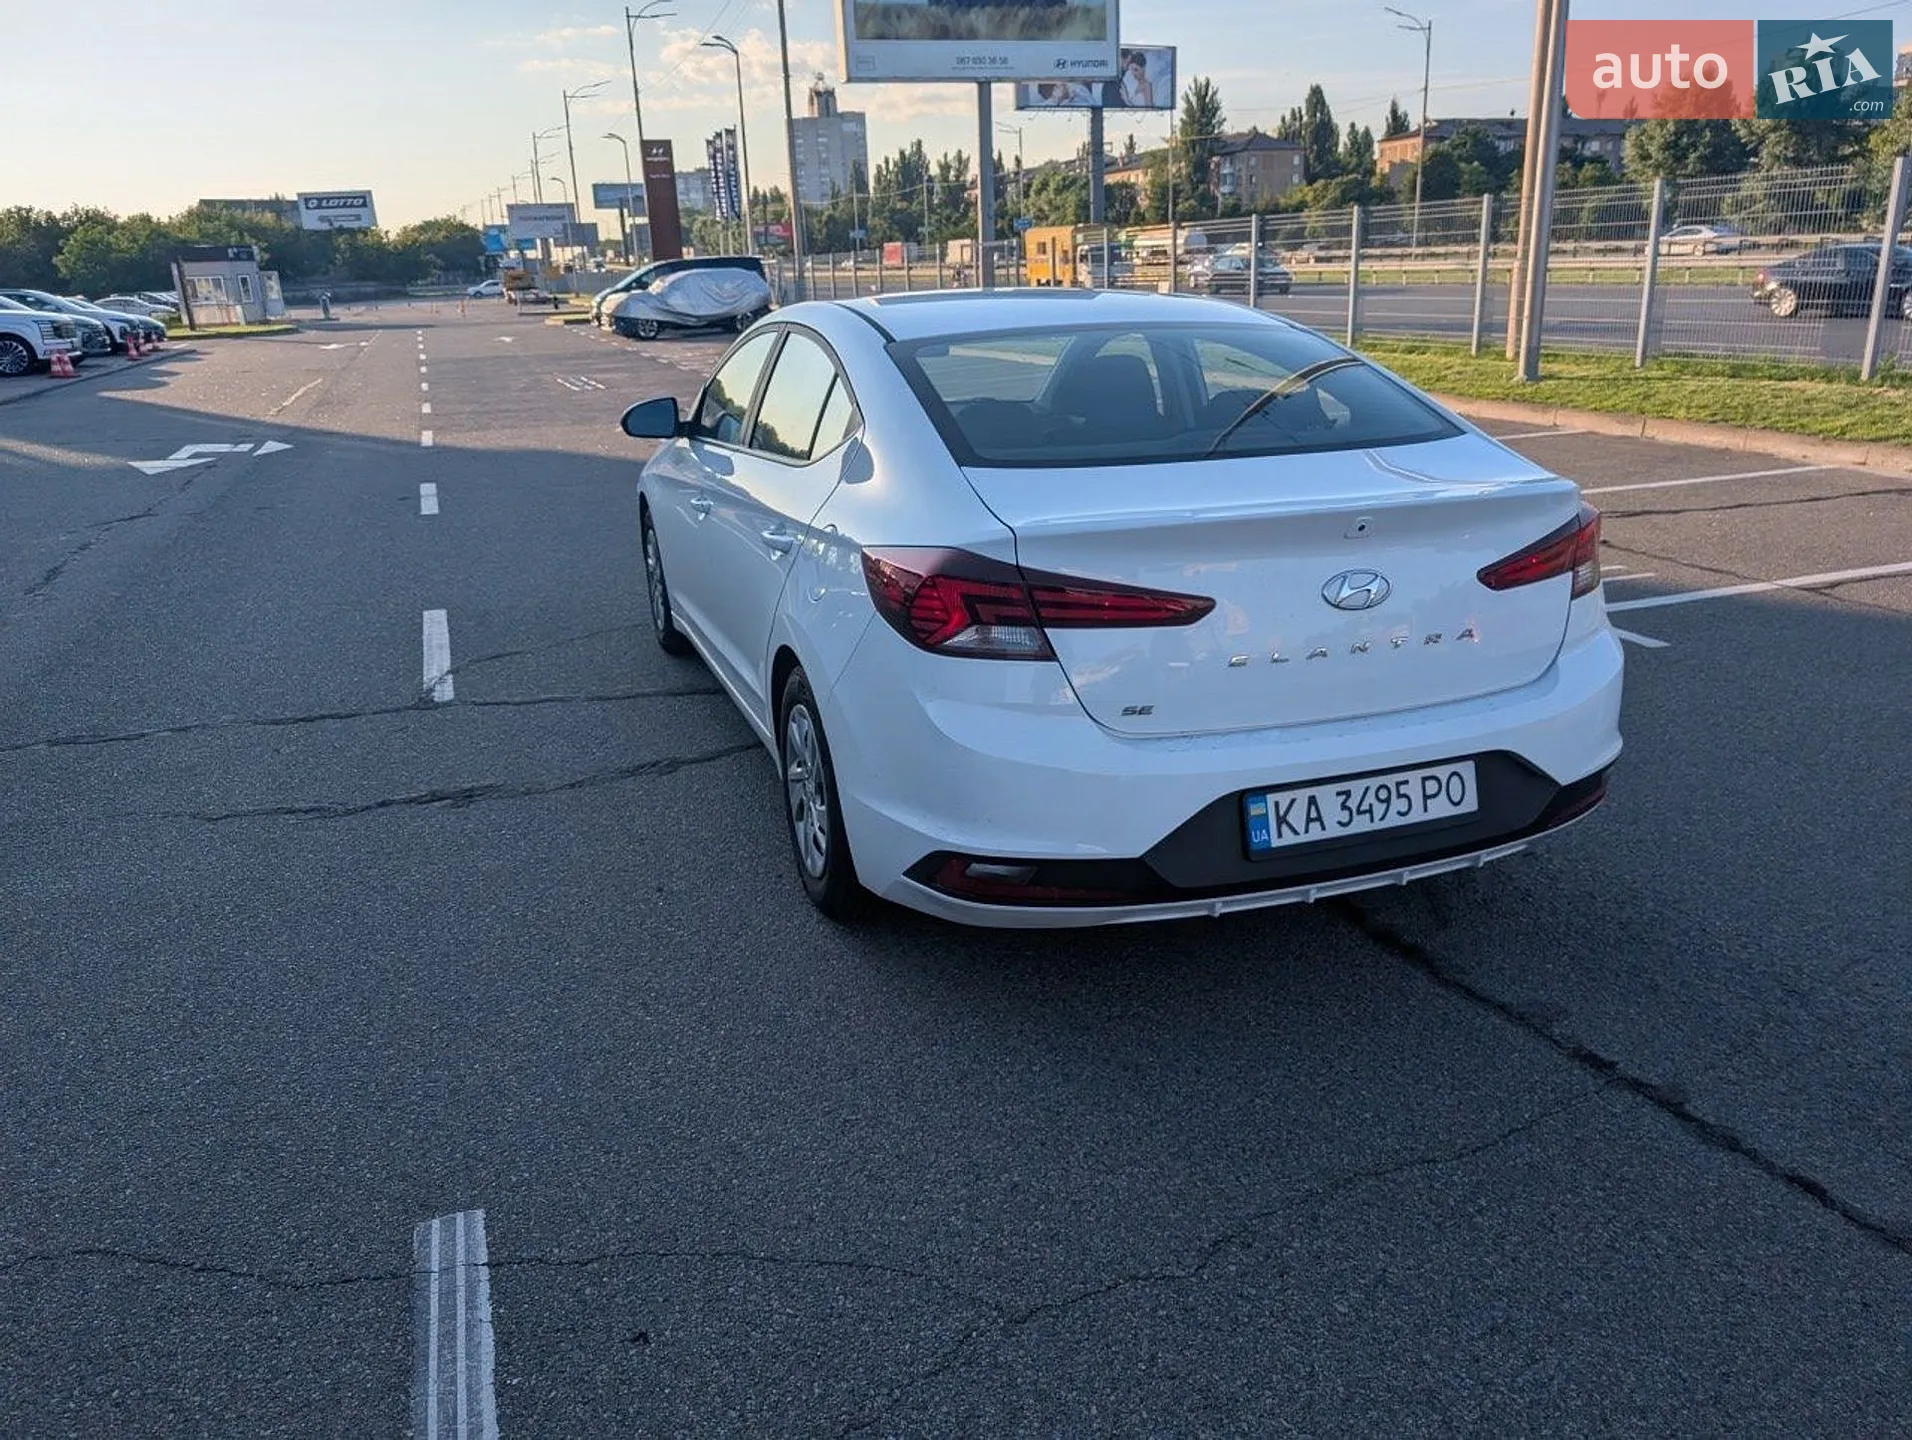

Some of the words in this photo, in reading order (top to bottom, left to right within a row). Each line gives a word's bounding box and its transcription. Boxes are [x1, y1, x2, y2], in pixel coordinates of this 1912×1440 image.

[1069, 59, 1109, 69] HYUNDAI
[1228, 628, 1480, 668] ELANTRA
[1121, 704, 1155, 717] SE
[1251, 828, 1269, 844] UA
[1273, 794, 1326, 839] KA
[1335, 779, 1413, 827] 3495
[1421, 770, 1466, 813] PO
